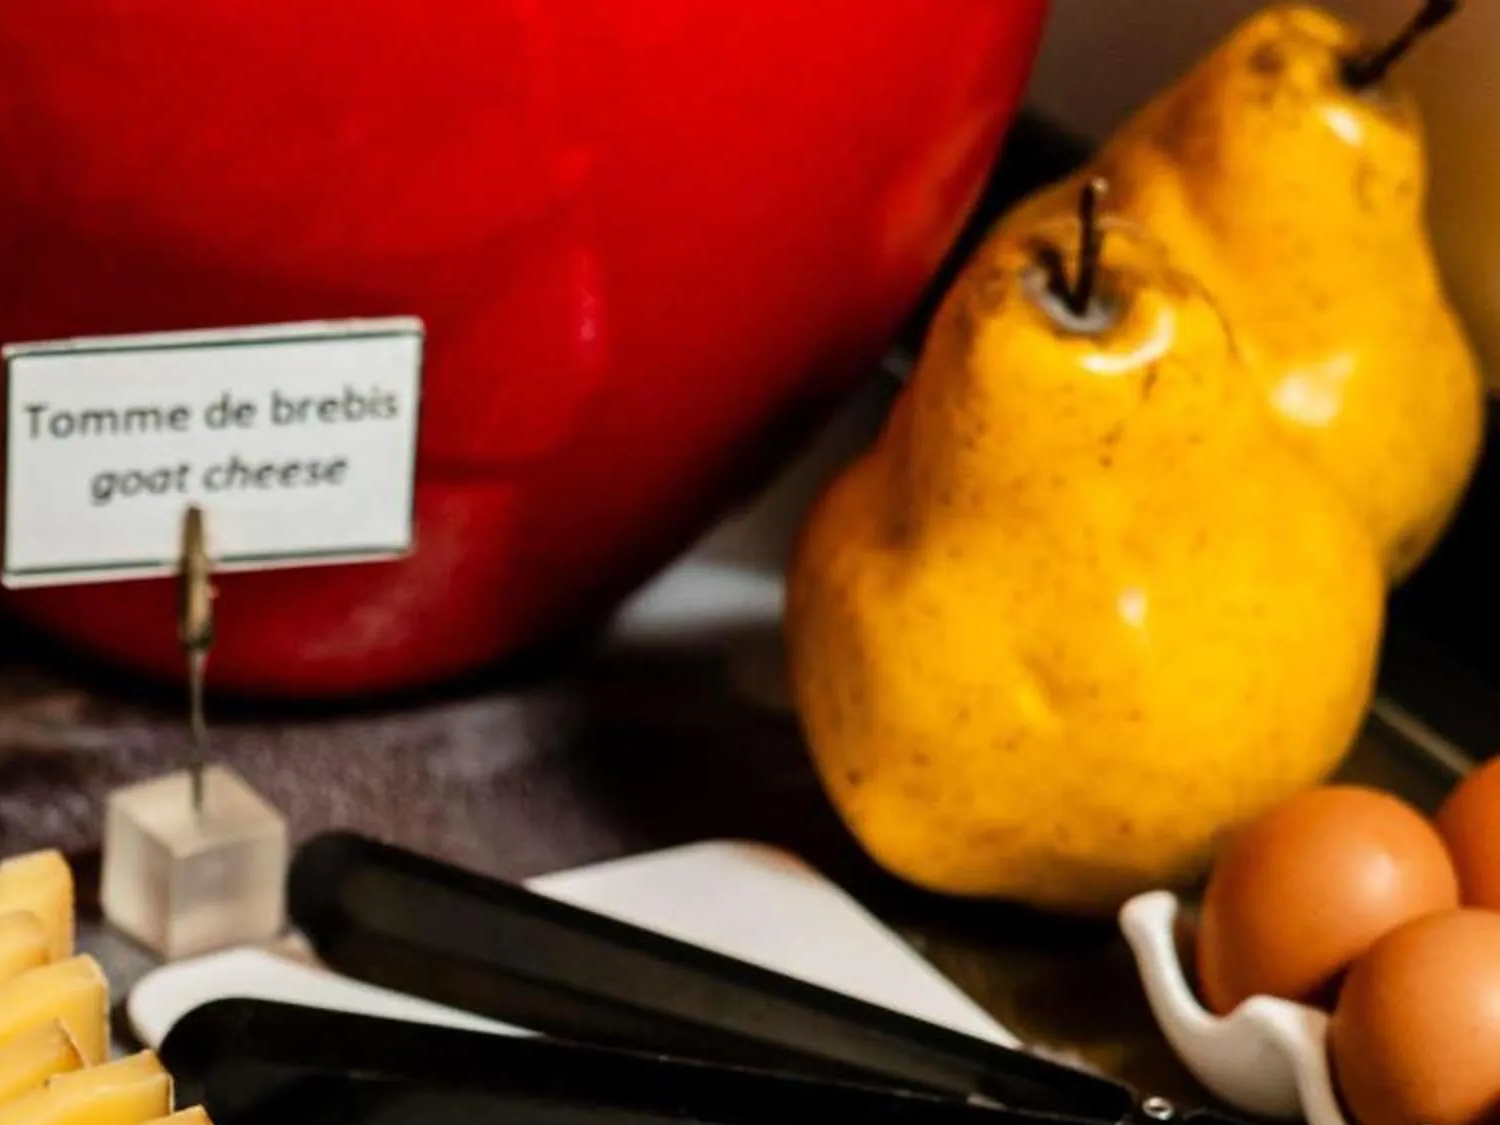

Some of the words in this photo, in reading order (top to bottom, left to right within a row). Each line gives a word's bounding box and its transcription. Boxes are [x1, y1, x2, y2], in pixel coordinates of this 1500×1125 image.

[26, 404, 190, 439] Tomme
[204, 394, 257, 430] de
[270, 385, 398, 426] brebis
[90, 463, 190, 507] goat
[203, 456, 348, 492] cheese
